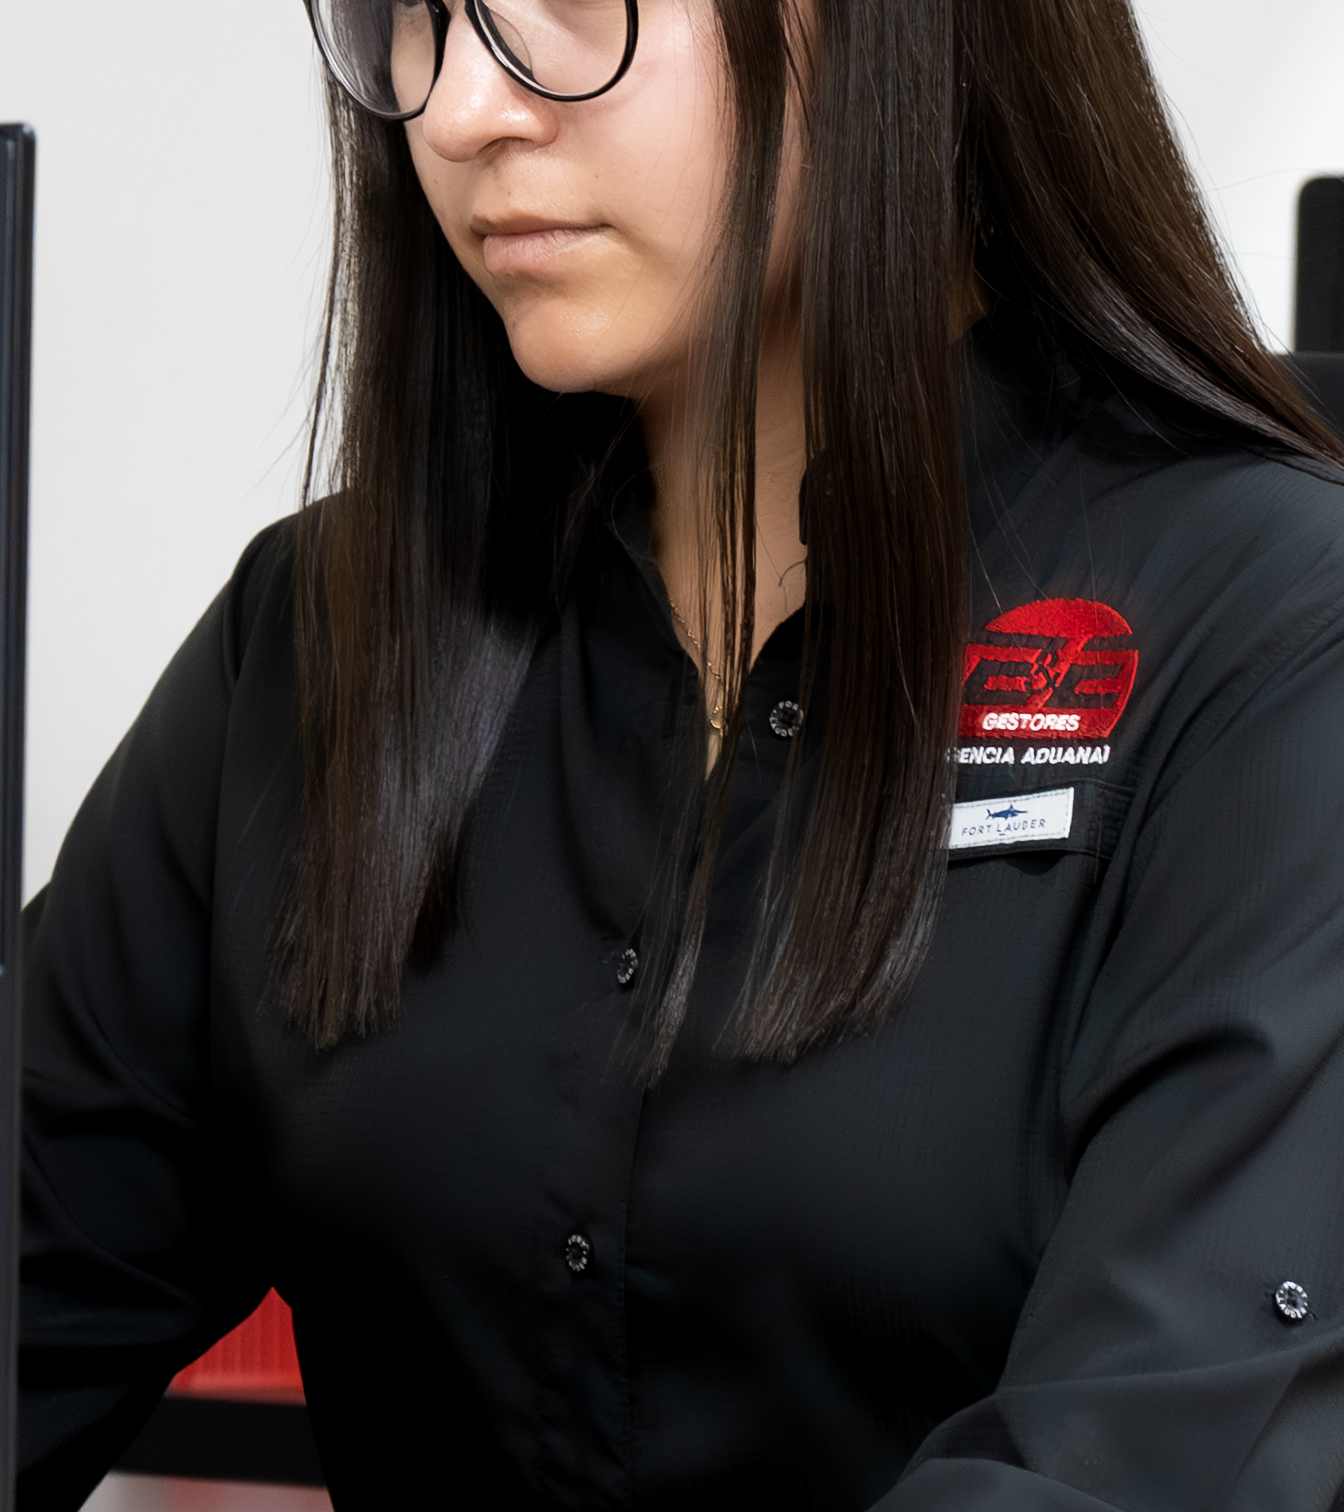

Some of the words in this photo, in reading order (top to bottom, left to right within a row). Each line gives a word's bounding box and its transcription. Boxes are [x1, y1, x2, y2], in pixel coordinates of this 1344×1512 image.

[982, 711, 1082, 732] GESTORES
[946, 746, 1015, 765] ENCIA
[961, 824, 993, 838] FORT
[996, 818, 1047, 836] LAUDER
